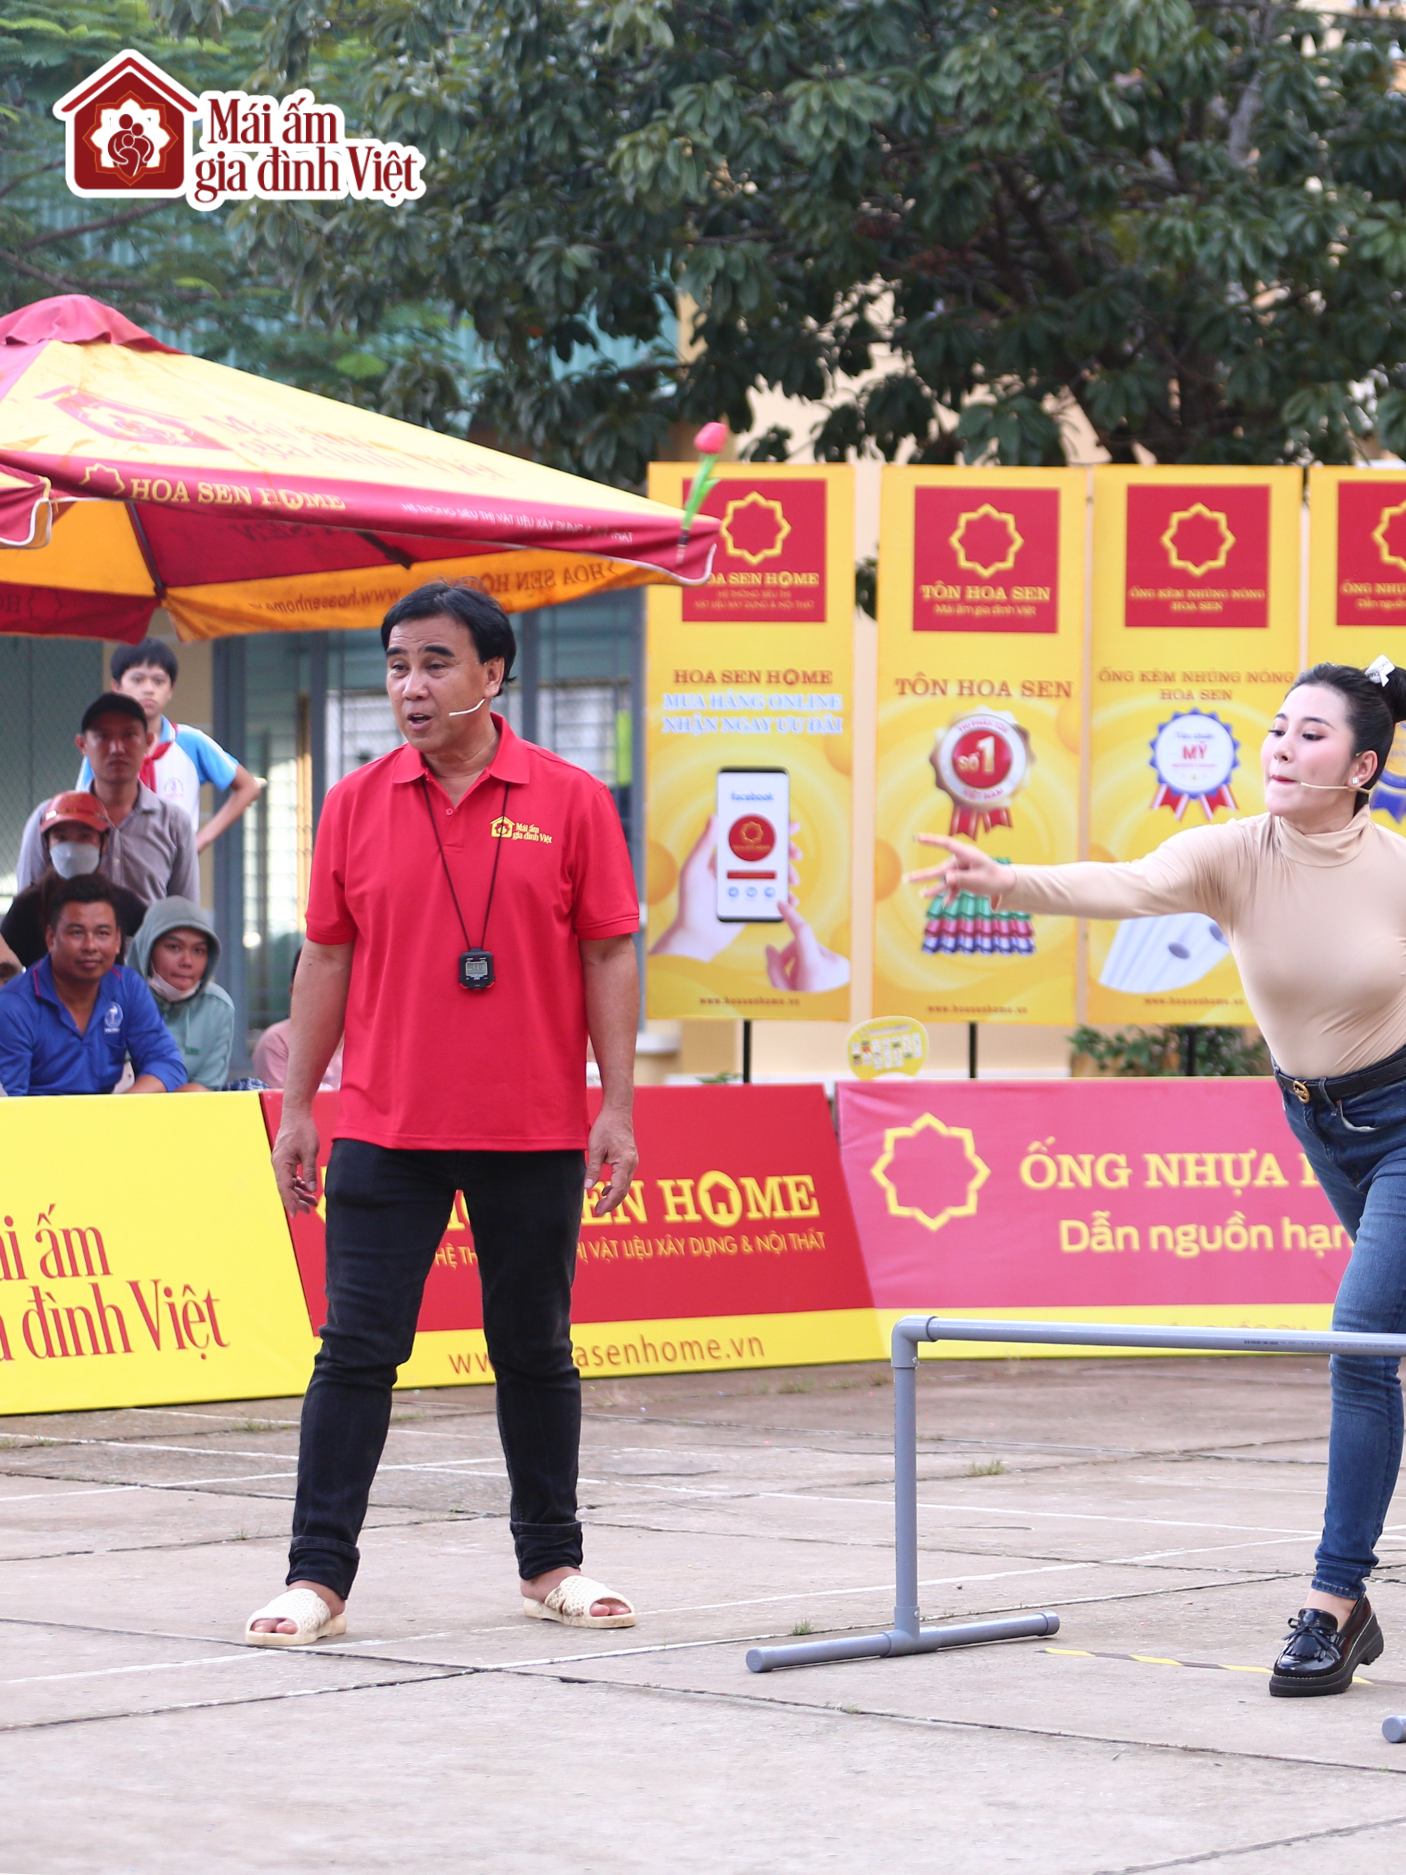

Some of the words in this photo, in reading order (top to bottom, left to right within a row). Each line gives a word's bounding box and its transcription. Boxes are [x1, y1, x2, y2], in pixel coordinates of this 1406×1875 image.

[131, 478, 189, 502] HOA
[197, 482, 253, 505] SEN
[261, 487, 346, 511] HOME
[707, 572, 727, 585] OA
[728, 571, 762, 585] SEN
[764, 570, 820, 587] HOME
[920, 580, 961, 599] TÔN
[965, 584, 1007, 600] HOA
[1011, 585, 1051, 600] SEN
[1171, 601, 1197, 612] HOA
[1200, 601, 1223, 612] SEN
[673, 669, 717, 684] HOA
[721, 669, 762, 684] SEN
[766, 668, 833, 685] HOME
[895, 671, 948, 696] TÔN
[957, 679, 1012, 697] HOA
[1021, 680, 1073, 698] SEN
[662, 693, 706, 710] MUA
[709, 689, 765, 711] HÀNG
[768, 693, 843, 711] ONLINE
[1160, 688, 1195, 700] HOA
[1200, 689, 1233, 701] SEN
[661, 712, 718, 737] NHẬN
[721, 716, 773, 733] NGAY
[977, 735, 996, 773] 1
[1019, 1135, 1132, 1190] ỐNG
[1143, 1146, 1288, 1197] NHỰA
[581, 1179, 647, 1226] EN
[657, 1170, 820, 1228] HOME
[34, 1203, 114, 1280] ấm
[589, 1235, 619, 1262] VẬT
[622, 1234, 653, 1260] LIỆU
[656, 1232, 685, 1257] XÂY
[694, 1234, 738, 1258] DỰNG
[742, 1234, 753, 1252] &
[757, 1228, 788, 1256] NỘI
[789, 1226, 826, 1250] THẤT
[1059, 1208, 1140, 1254] Dẫn
[1149, 1209, 1273, 1258] nguồn
[1281, 1215, 1355, 1258] hạn
[22, 1282, 136, 1360] đình
[125, 1279, 231, 1361] Việt
[448, 1334, 766, 1377] wwasenhome.vn
